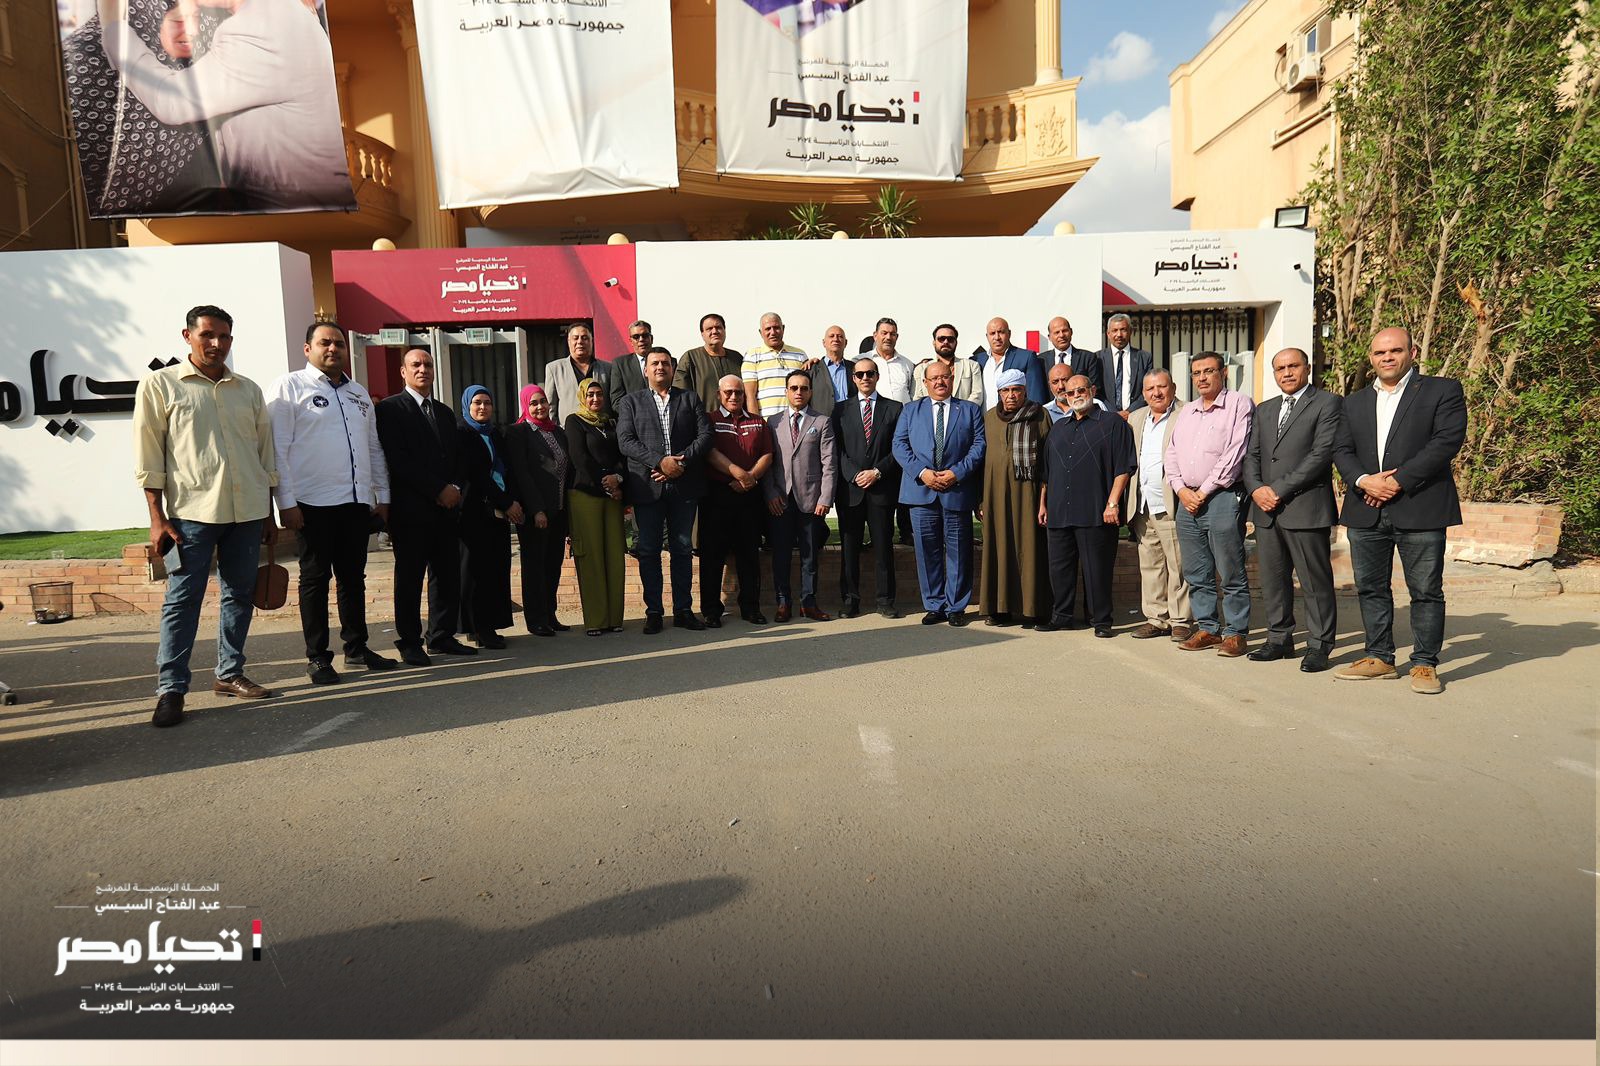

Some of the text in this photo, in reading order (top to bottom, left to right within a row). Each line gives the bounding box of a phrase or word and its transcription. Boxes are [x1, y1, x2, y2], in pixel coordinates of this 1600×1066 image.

[459, 16, 512, 33] العربية
[558, 15, 624, 33] جمهورية
[842, 72, 871, 84] الفتاح
[874, 74, 890, 85] عبد
[767, 90, 906, 132] تحيا مصر
[851, 140, 889, 149] الانتخابات
[785, 149, 899, 166] جمهورية مصر العربية
[1154, 253, 1230, 278] تحيا مصر
[441, 272, 520, 299] تحيا مصر
